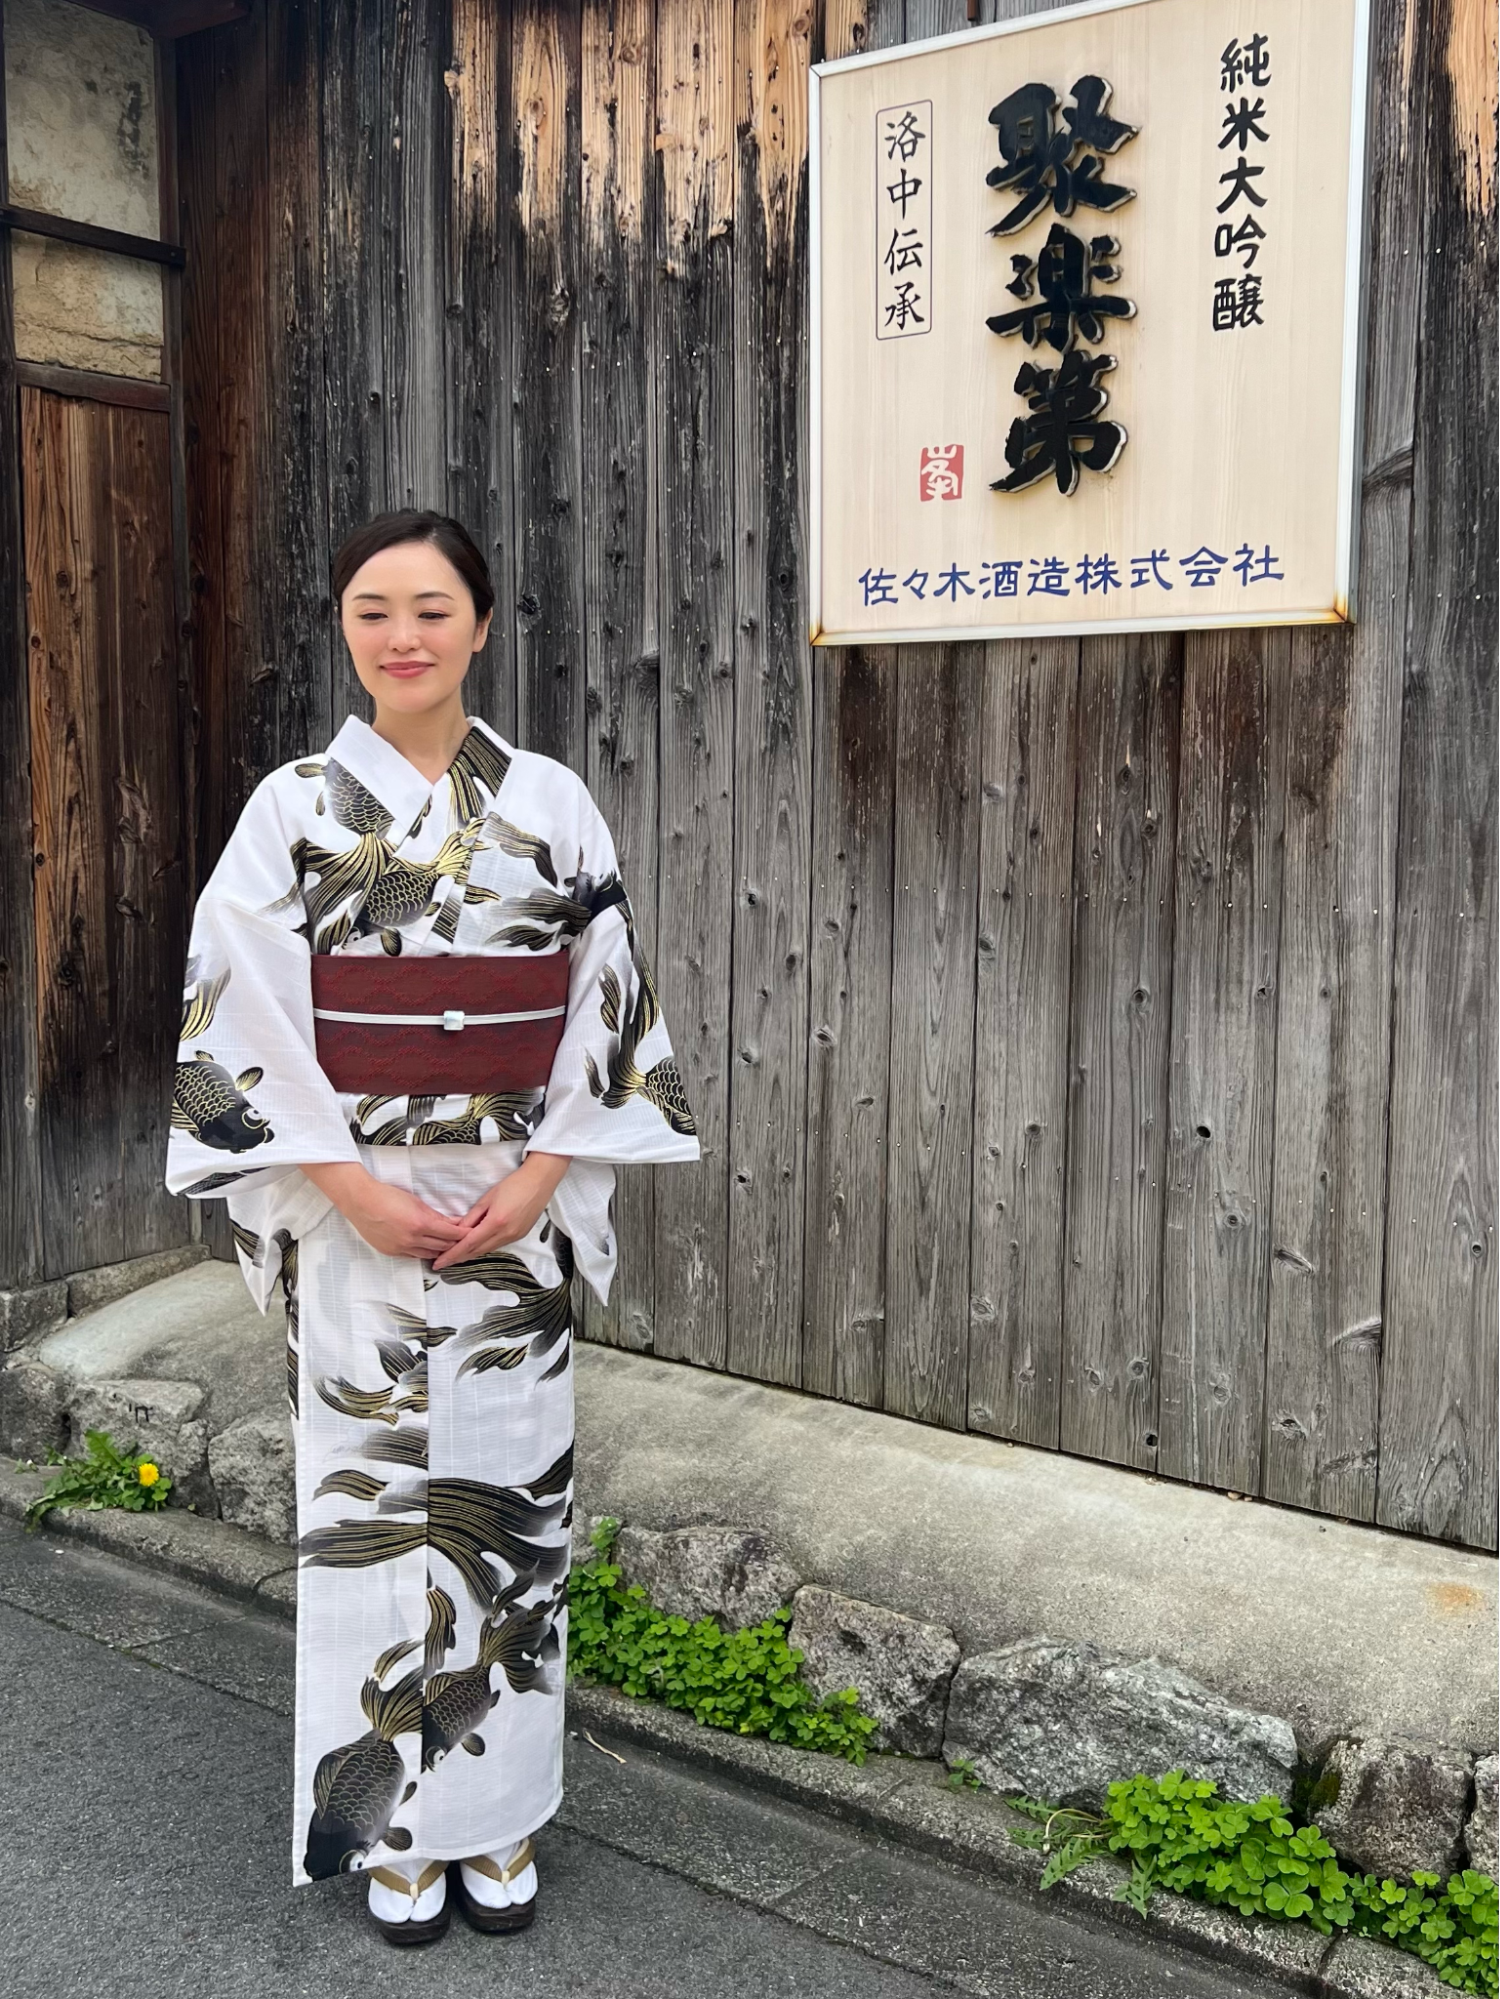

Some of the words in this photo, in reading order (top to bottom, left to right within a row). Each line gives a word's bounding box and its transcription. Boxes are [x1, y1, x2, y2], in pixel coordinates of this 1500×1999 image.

[883, 111, 926, 331] 洛中伝承
[1212, 33, 1272, 332] 純米大吟醸
[858, 542, 1285, 607] 佐々木酒造株式会社
